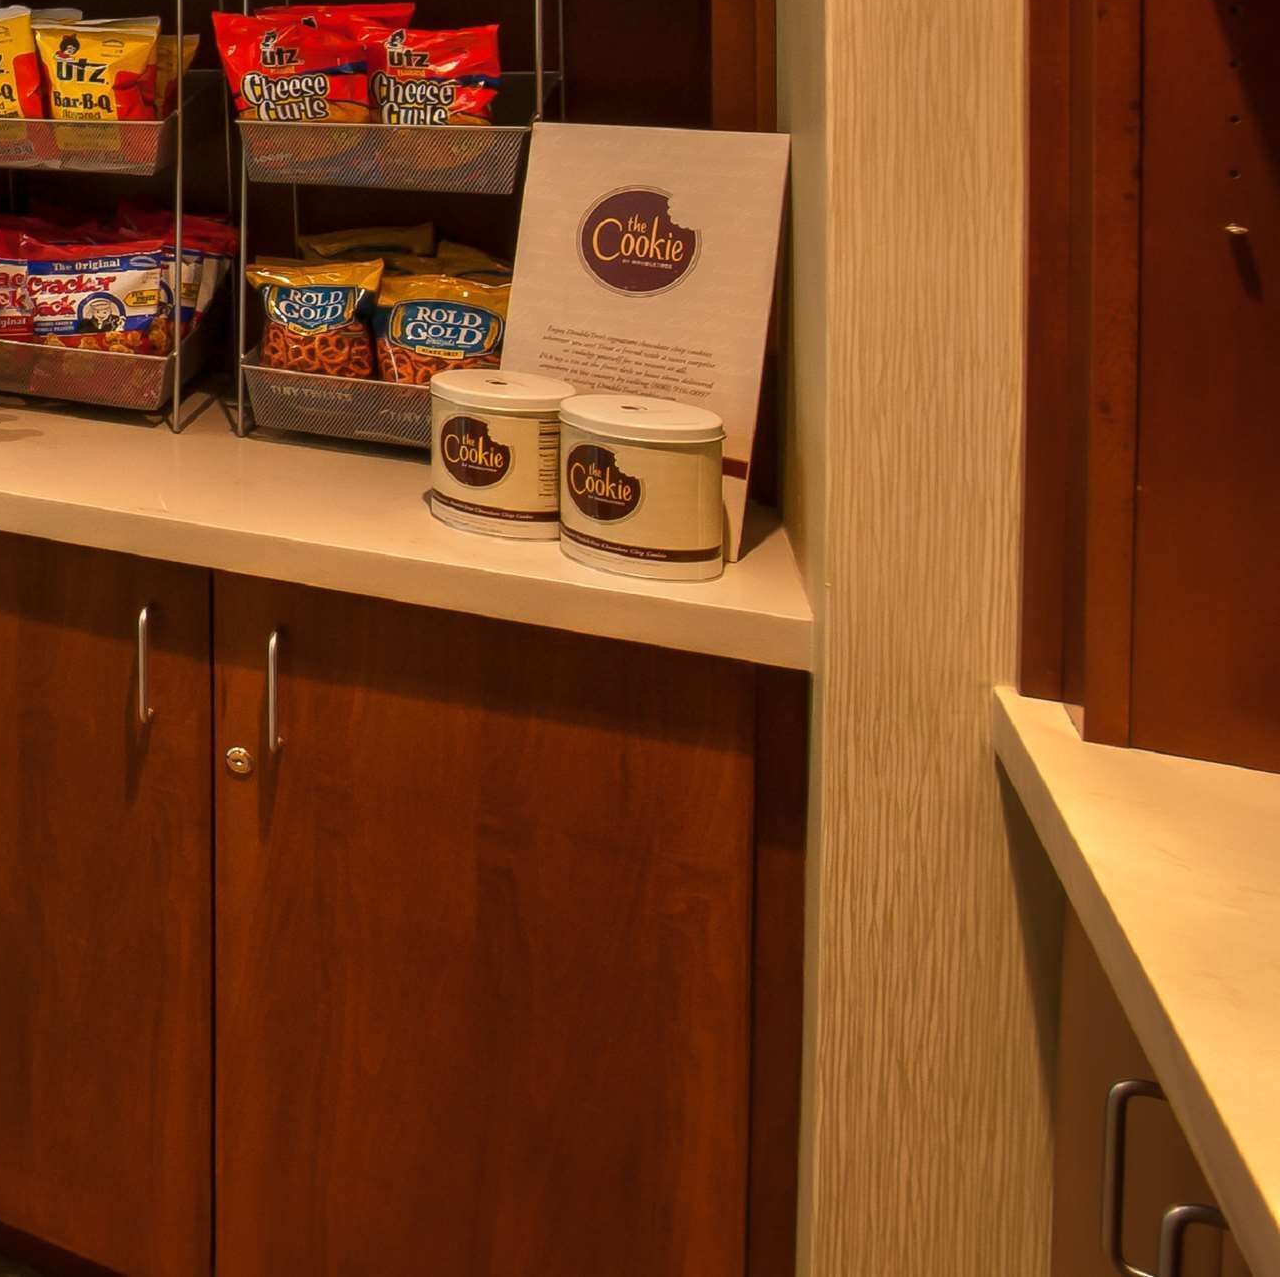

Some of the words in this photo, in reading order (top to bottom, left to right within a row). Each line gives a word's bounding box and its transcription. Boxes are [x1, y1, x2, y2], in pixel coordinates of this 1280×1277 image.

[243, 72, 329, 104] Cheese
[371, 72, 456, 106] Cheese
[257, 96, 329, 122] Curls
[381, 102, 450, 125] Curls
[628, 213, 647, 233] the
[593, 216, 683, 262] Cookie
[52, 262, 73, 271] The
[75, 258, 121, 271] Original
[28, 275, 117, 297] Cracker
[288, 289, 343, 306] ROLD
[279, 300, 344, 321] GOLD
[415, 306, 482, 328] ROLD
[405, 321, 483, 345] GOLD
[444, 433, 504, 468] Cookie
[462, 434, 475, 447] the
[589, 462, 602, 478] the
[570, 462, 633, 502] Cookie
